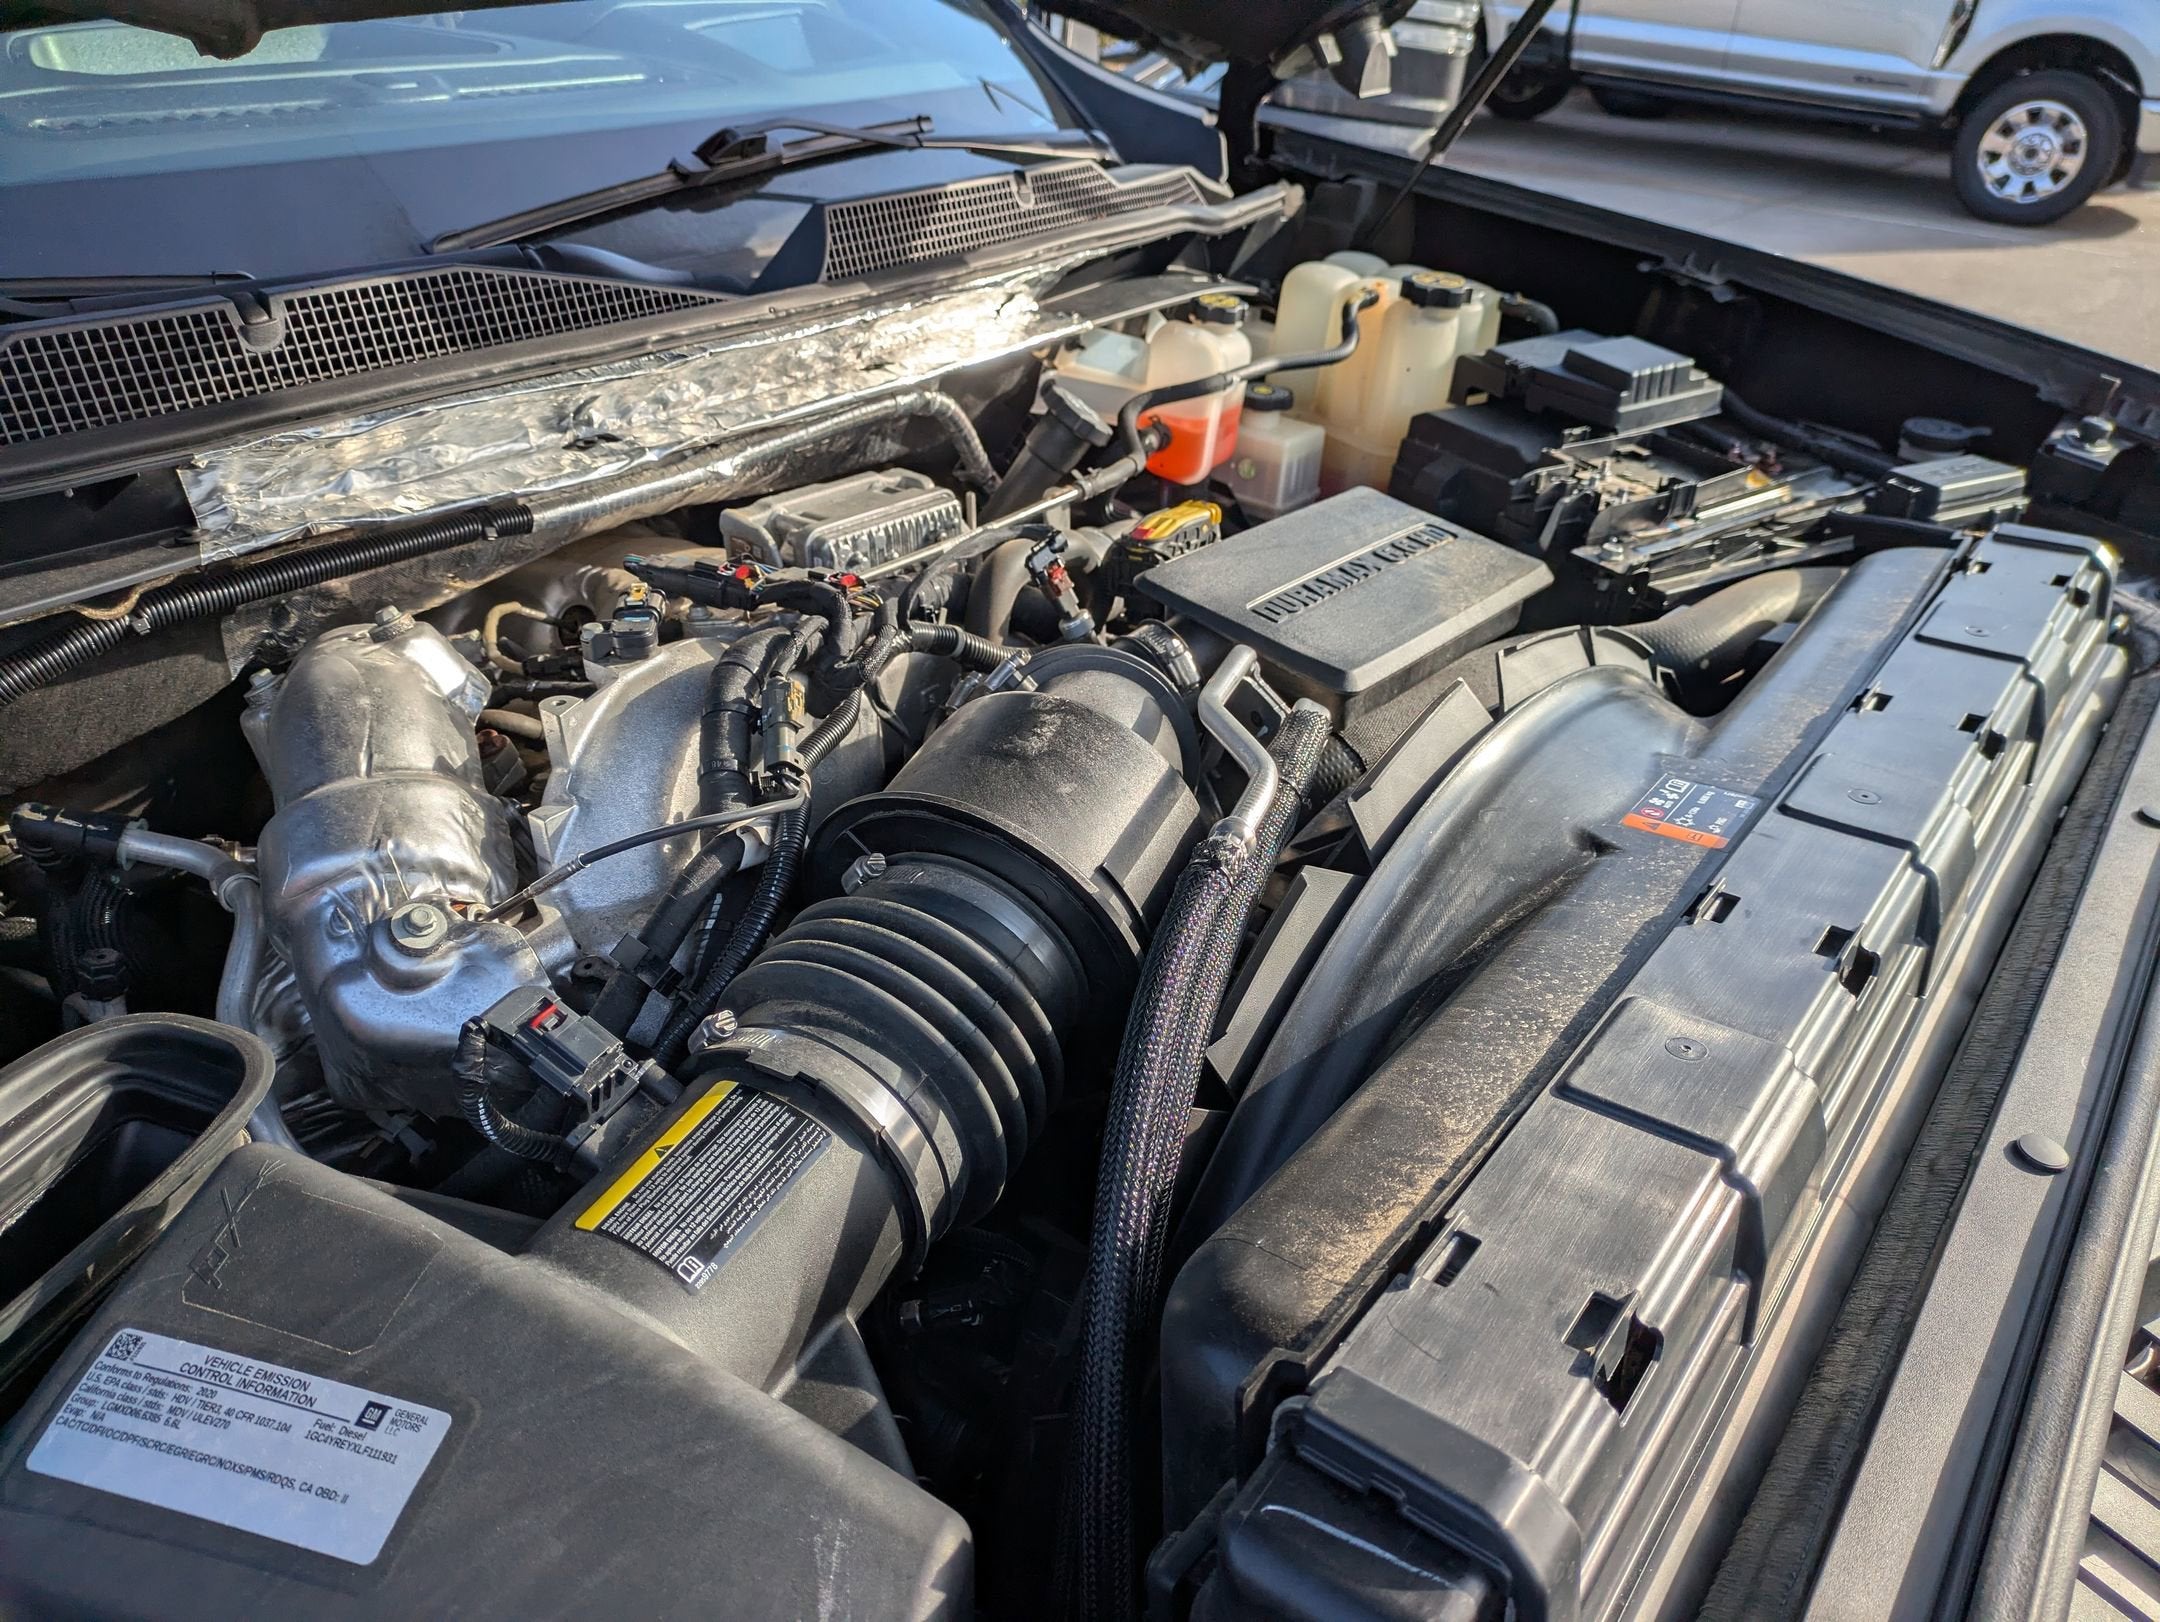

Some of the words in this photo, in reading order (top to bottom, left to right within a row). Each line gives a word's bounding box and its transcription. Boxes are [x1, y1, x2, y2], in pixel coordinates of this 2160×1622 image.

[1252, 556, 1384, 625] DURAMAX
[94, 1361, 134, 1377] Conforms
[133, 1371, 144, 1379] to
[141, 1373, 194, 1395] Regulations:
[196, 1387, 218, 1399] 2020
[179, 1363, 237, 1385] CONTROL
[235, 1378, 318, 1407] INFORMATION
[203, 1356, 254, 1376] VEHICLE
[253, 1369, 311, 1391] EMISSION
[62, 1405, 87, 1418] Evap:
[90, 1411, 107, 1420] N/A
[70, 1394, 100, 1408] Group:
[163, 1418, 183, 1429] 6.6L
[79, 1382, 118, 1398] California
[117, 1392, 139, 1404] class
[143, 1399, 165, 1411] stds:
[168, 1406, 188, 1417] MDV
[192, 1413, 231, 1429] ULEV270
[103, 1377, 122, 1387] EPA
[121, 1381, 144, 1392] class
[147, 1388, 170, 1399] stds:
[172, 1394, 192, 1405] HDV
[234, 1411, 255, 1422] CFR
[254, 1416, 293, 1433] 1037.104
[365, 1408, 383, 1421] GM
[394, 1409, 430, 1424] GENERAL
[313, 1419, 337, 1432] Fuel:
[338, 1426, 368, 1440] Diesel
[384, 1426, 400, 1436] LLC
[389, 1418, 422, 1432] MOTORS
[298, 1482, 314, 1494] CA
[314, 1487, 341, 1501] OBD:
